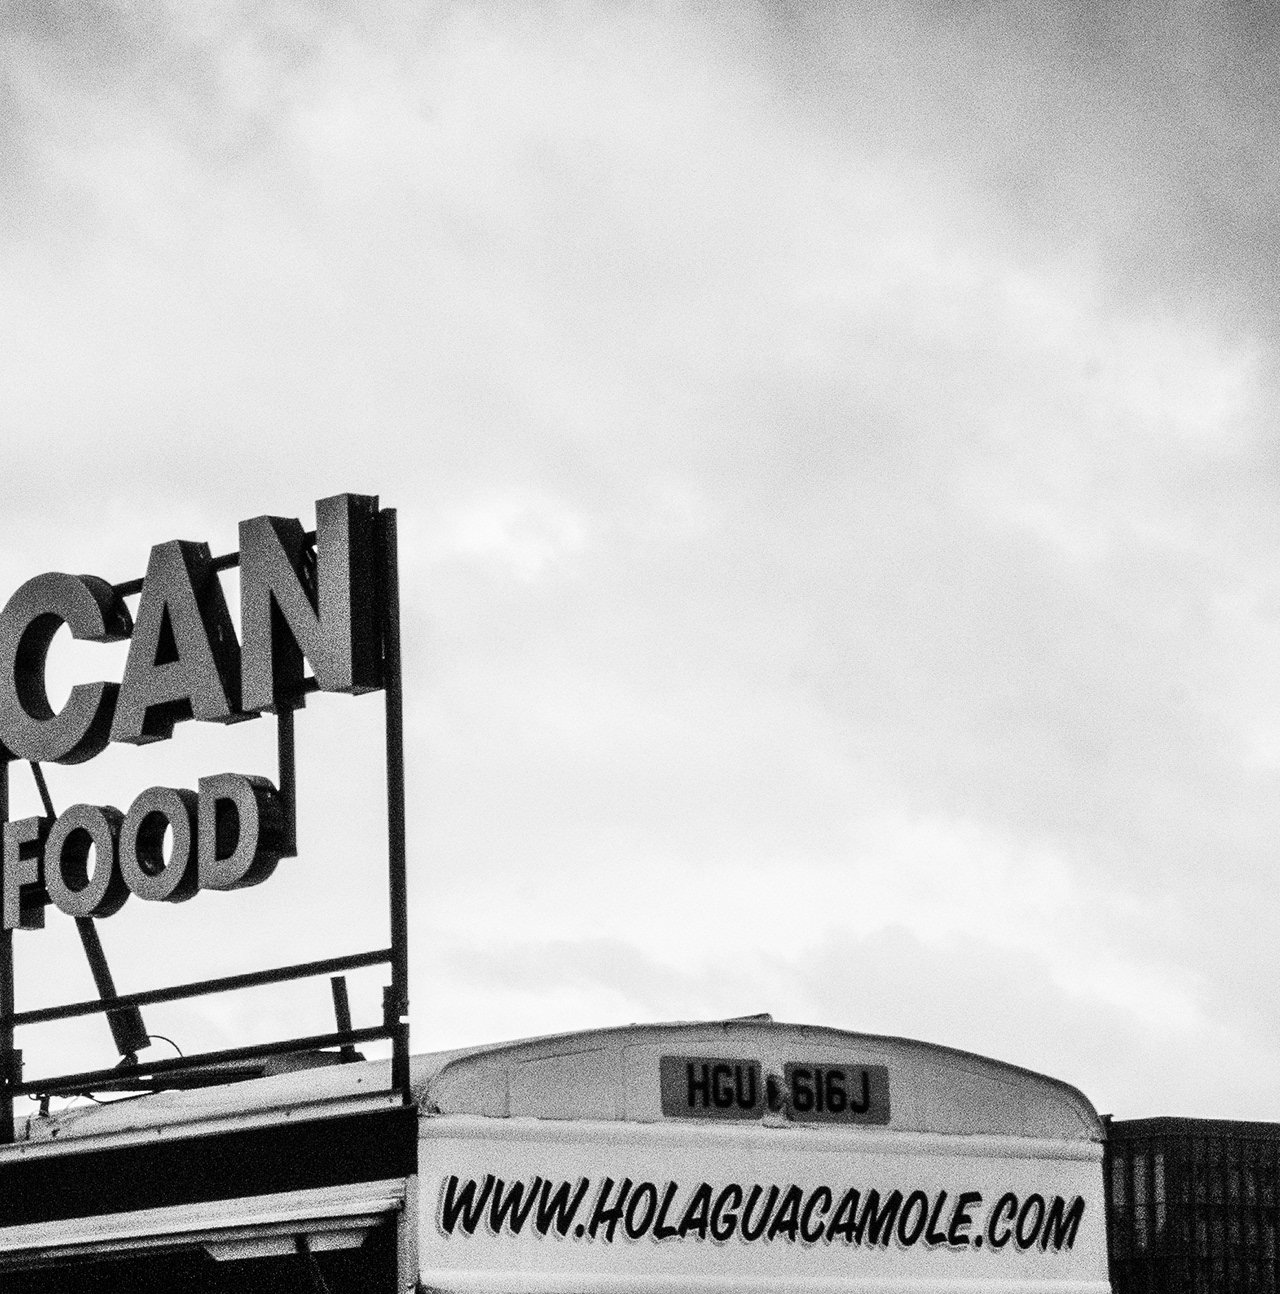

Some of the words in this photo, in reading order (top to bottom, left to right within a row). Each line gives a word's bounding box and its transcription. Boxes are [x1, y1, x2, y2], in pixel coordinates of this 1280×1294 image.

[3, 773, 282, 932] FOOD
[686, 1063, 757, 1111] HGU
[792, 1069, 871, 1114] 616J
[440, 1174, 1085, 1251] WWW.HOLAGUACAMOLE.COM
